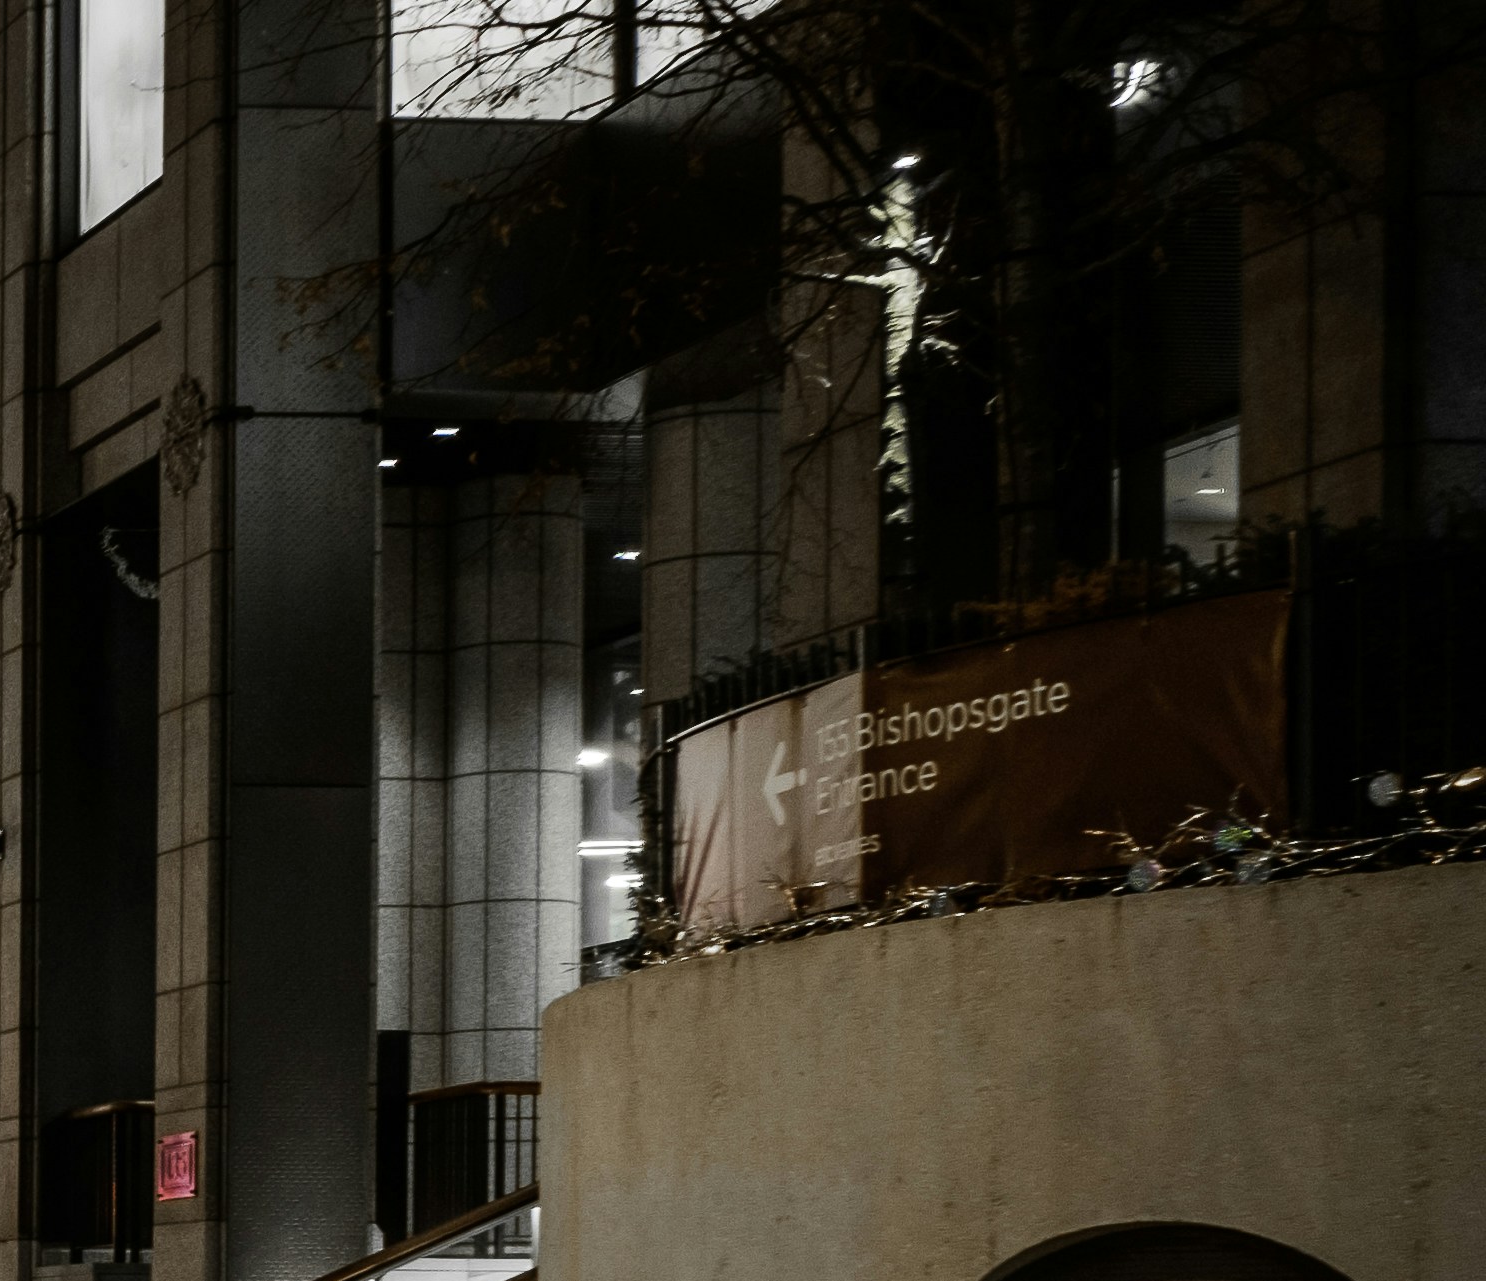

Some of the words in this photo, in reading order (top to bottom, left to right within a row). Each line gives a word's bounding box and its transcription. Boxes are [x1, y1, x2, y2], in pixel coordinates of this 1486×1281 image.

[817, 717, 849, 764] 155
[855, 679, 1070, 752] Bishopsgate
[817, 760, 939, 816] Entrance
